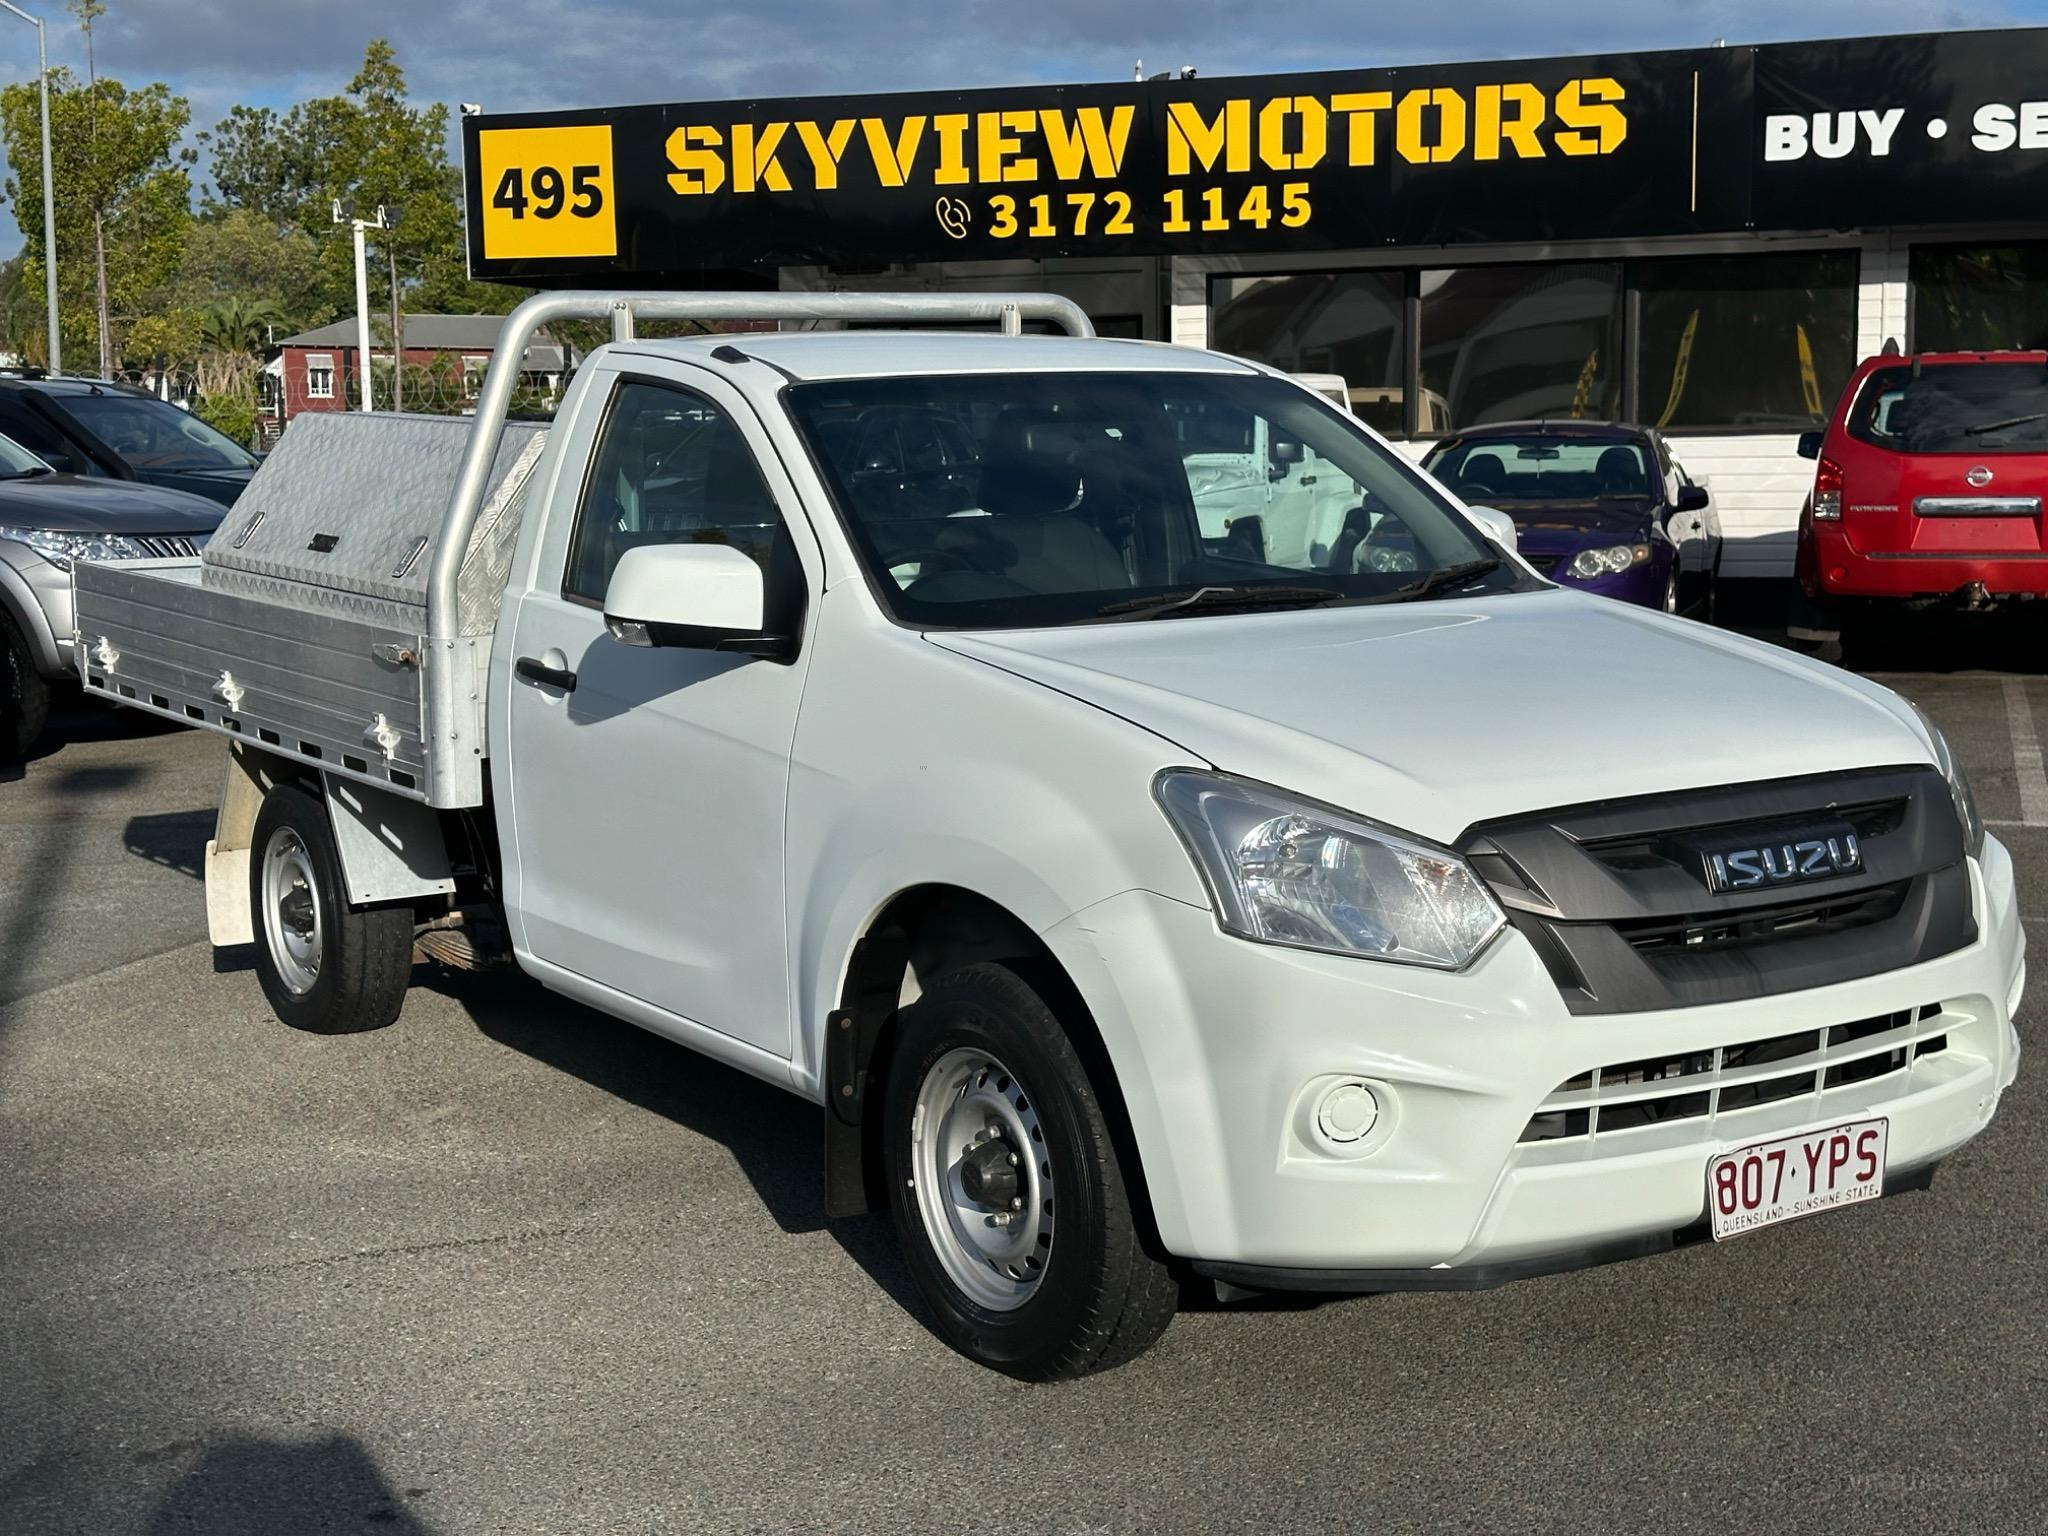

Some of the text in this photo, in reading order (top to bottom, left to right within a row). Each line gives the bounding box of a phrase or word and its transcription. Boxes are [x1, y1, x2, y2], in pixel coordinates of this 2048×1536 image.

[665, 77, 1628, 194] SKYVIEW MOTORS
[1764, 108, 1905, 162] BUY
[492, 165, 604, 221] 495
[989, 182, 1313, 239] 3172 1145
[1712, 834, 1861, 889] ISUZU
[1716, 1129, 1879, 1216] 807 YPS
[1722, 1206, 1784, 1233] QUEENSLAND
[1793, 1191, 1840, 1215] SUNSHINE
[1845, 1183, 1876, 1202] STATE
